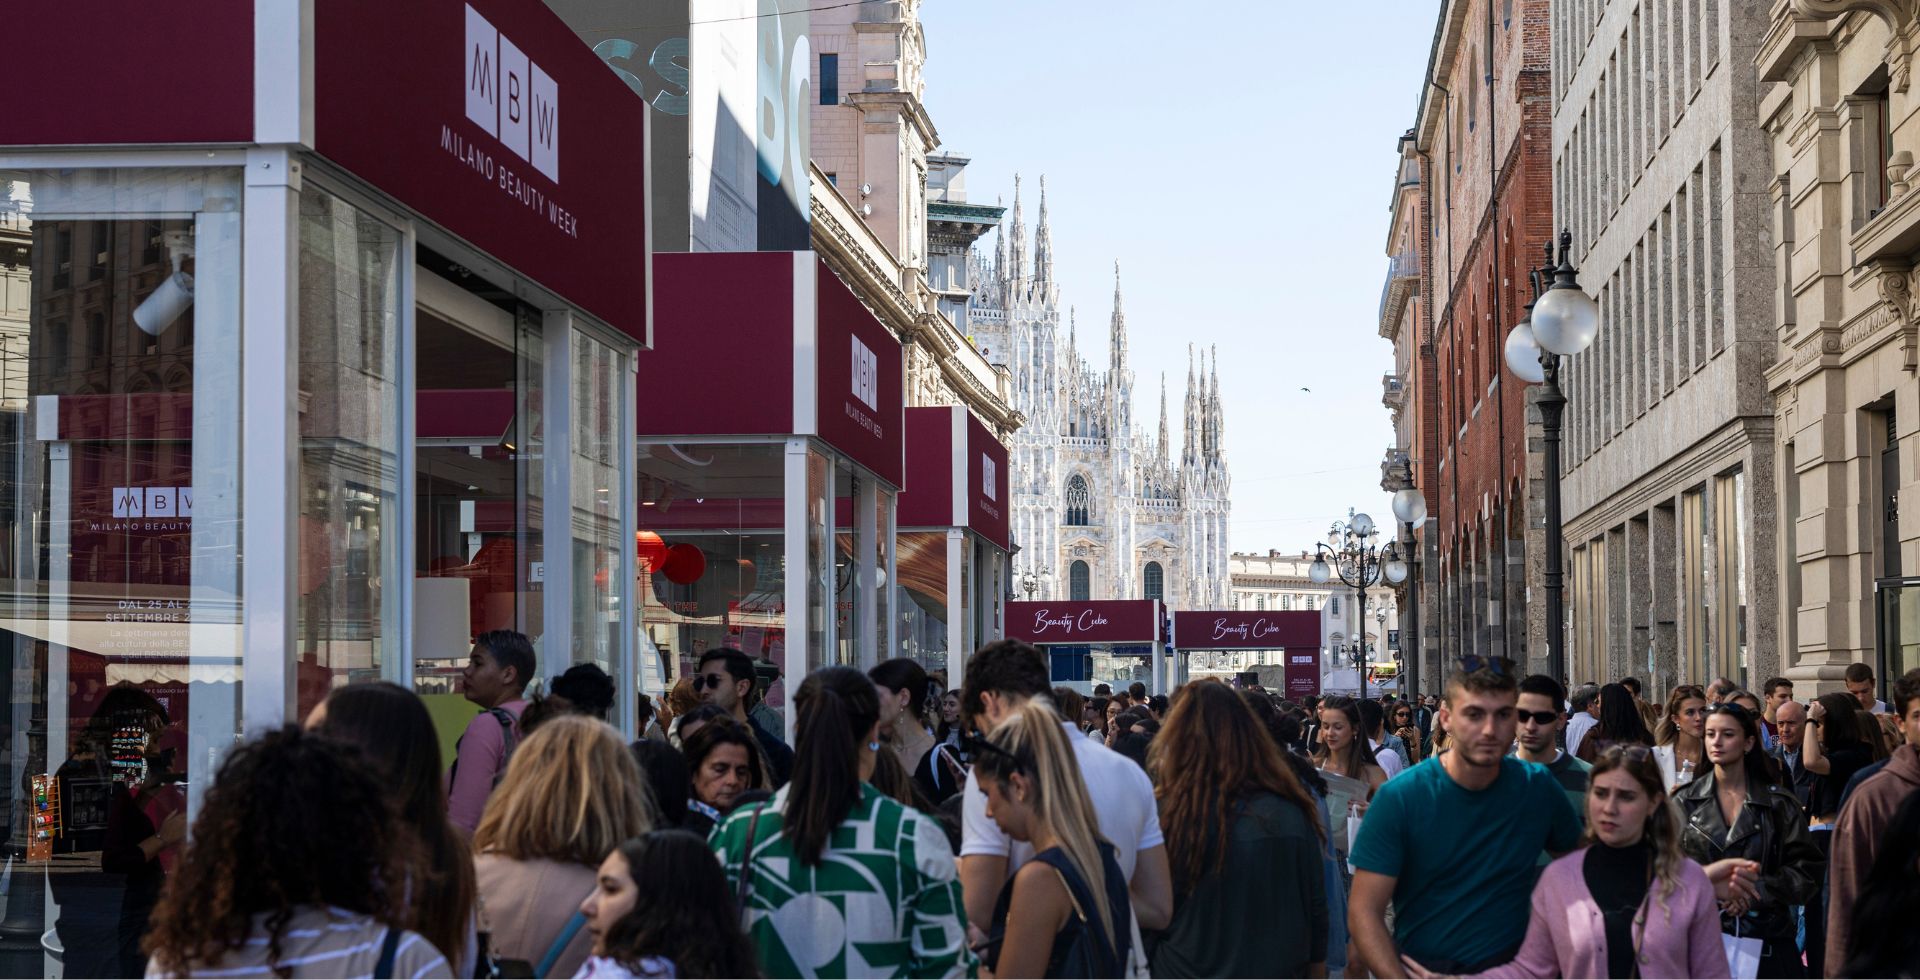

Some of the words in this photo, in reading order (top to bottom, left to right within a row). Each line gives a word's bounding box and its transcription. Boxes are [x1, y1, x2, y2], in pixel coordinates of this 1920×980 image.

[472, 42, 554, 151] MBW
[441, 124, 494, 181] MILANO
[499, 165, 544, 215] BEAUTY
[548, 200, 578, 240] WEEK
[90, 522, 140, 532] MILANO
[144, 521, 192, 532] BEAUTY
[118, 600, 144, 610] DAL
[148, 600, 163, 610] 25
[167, 600, 184, 610] AL
[105, 612, 180, 622] SETTEMBRE
[1032, 608, 1075, 634] Beauty
[1077, 608, 1109, 632] Cube
[1212, 617, 1250, 640] Beauty
[1252, 618, 1281, 638] Cube
